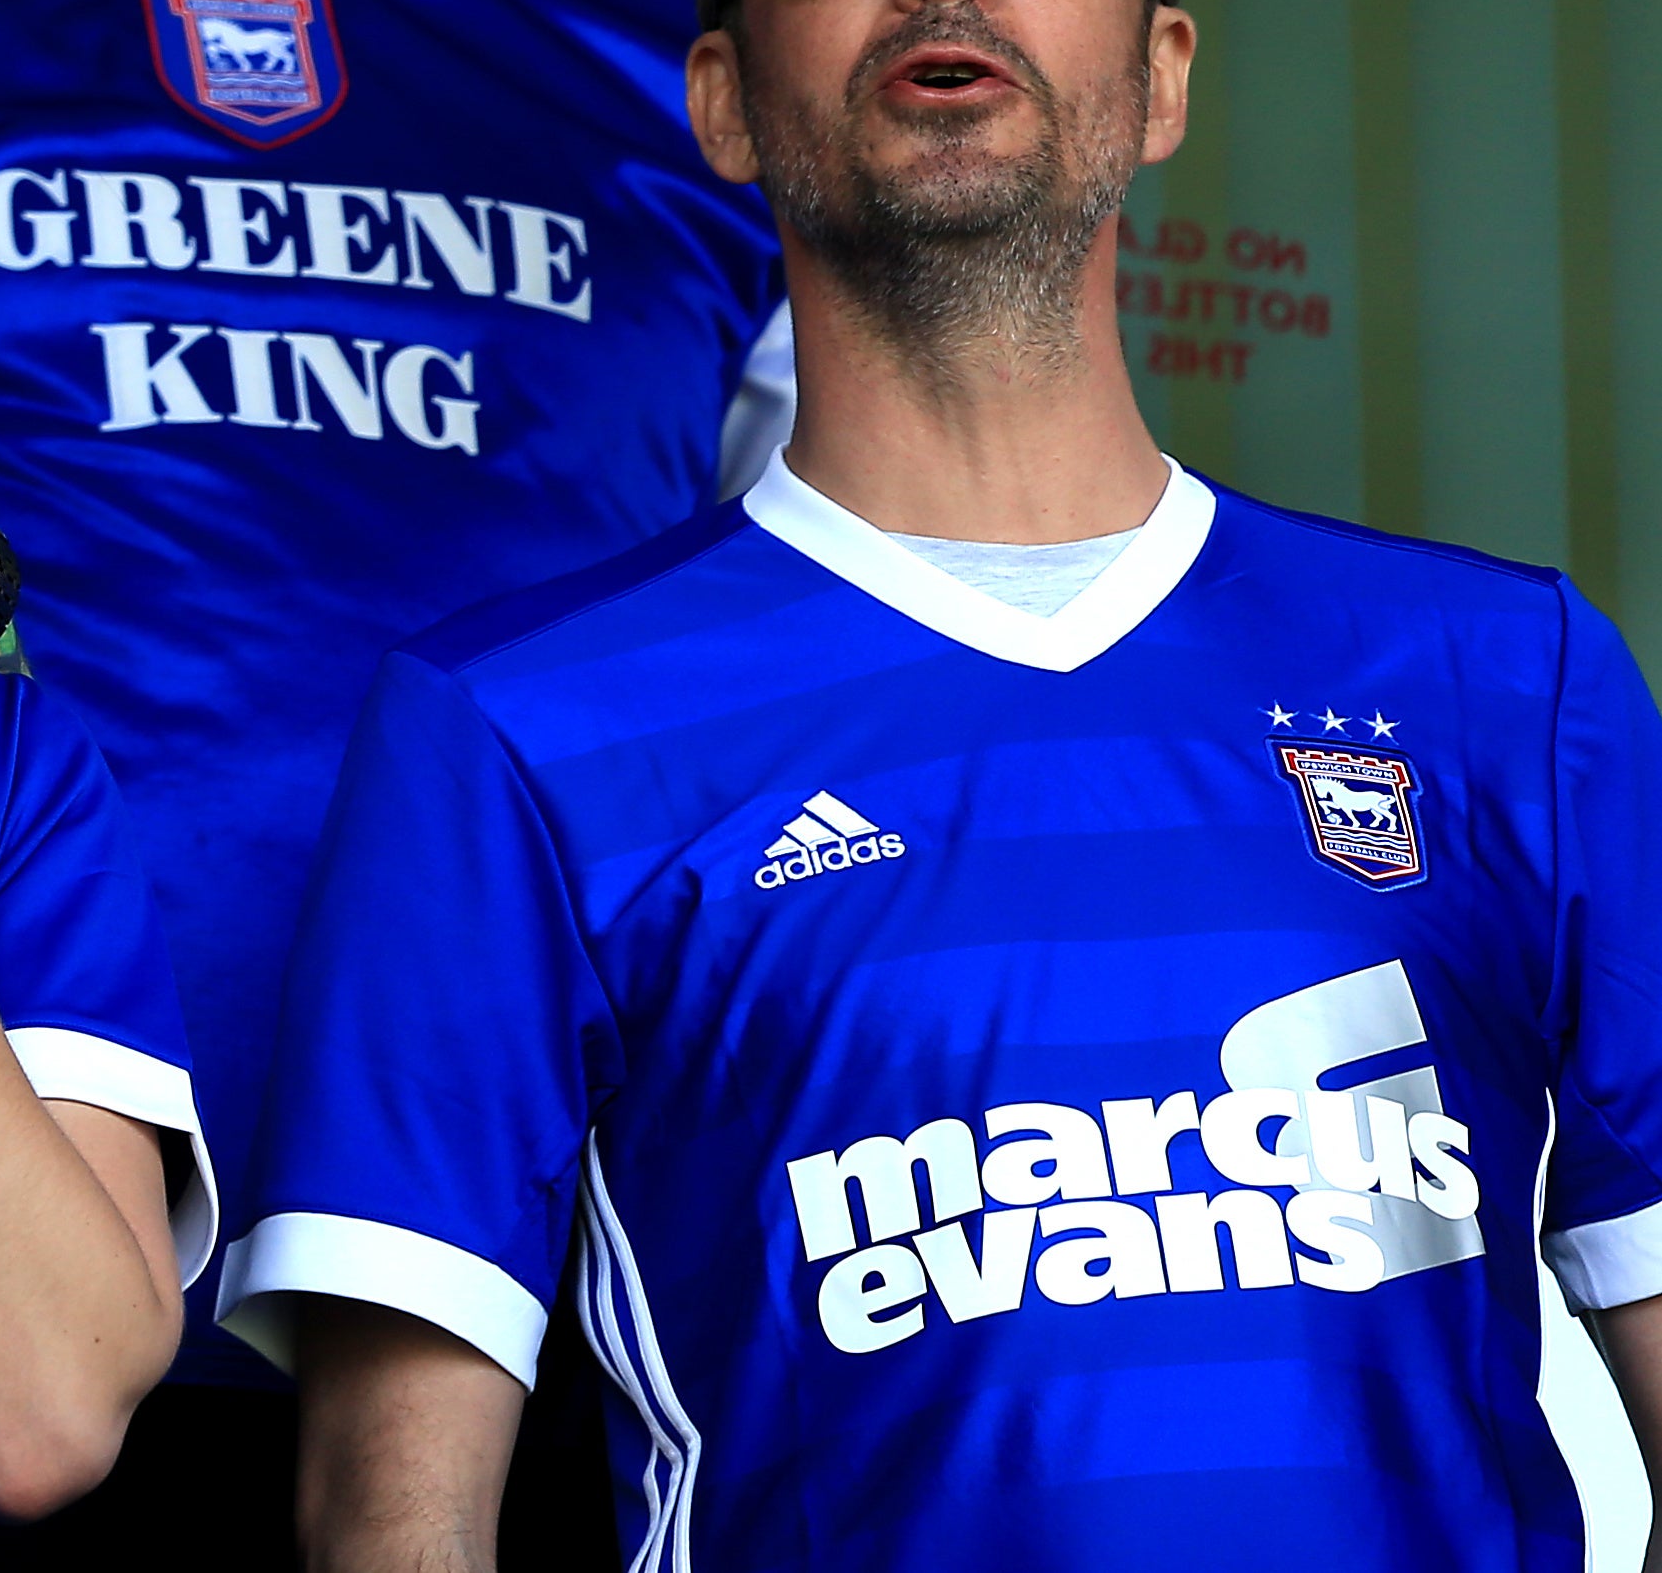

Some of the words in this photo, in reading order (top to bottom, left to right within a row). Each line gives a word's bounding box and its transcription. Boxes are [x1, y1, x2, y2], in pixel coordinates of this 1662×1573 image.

[89, 322, 480, 456] KING
[1300, 760, 1352, 774] IPSWICH
[1353, 766, 1394, 779] TOWN
[754, 833, 907, 889] adidas
[785, 1088, 1480, 1263] marcus
[817, 1188, 1386, 1356] evans
